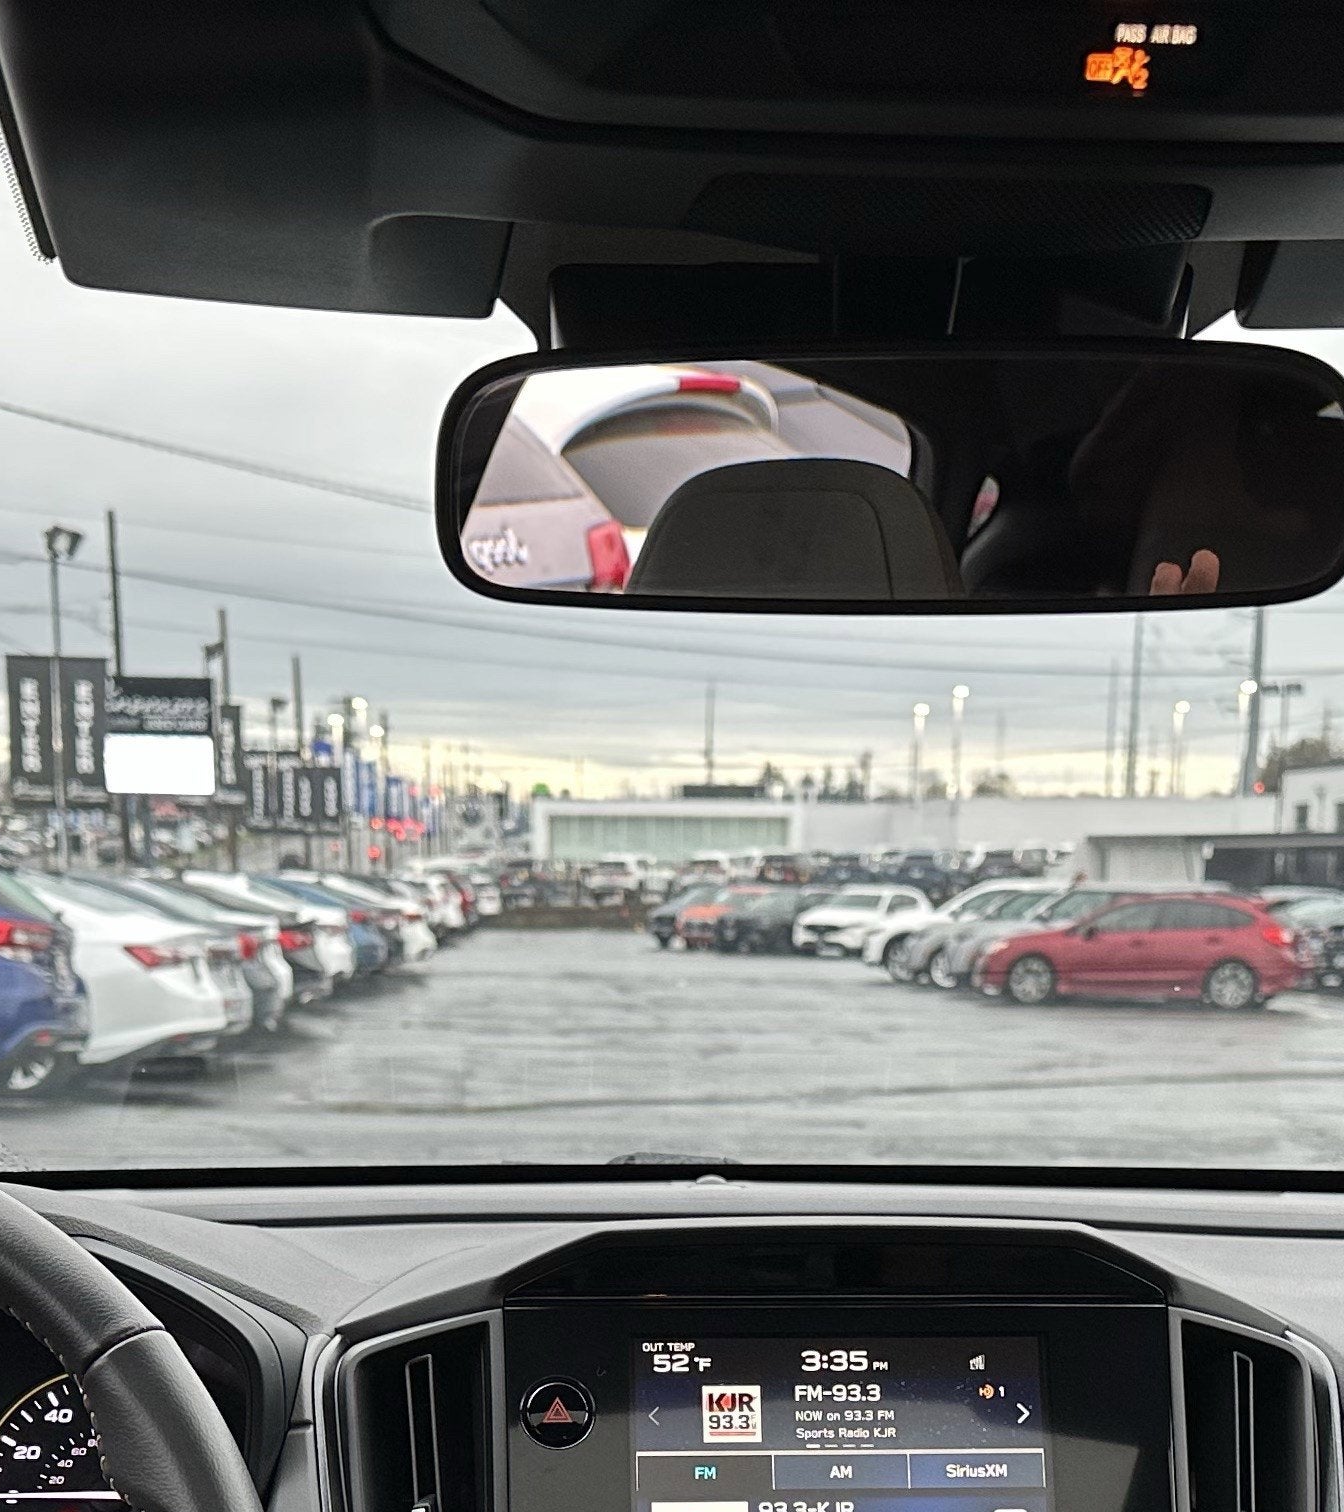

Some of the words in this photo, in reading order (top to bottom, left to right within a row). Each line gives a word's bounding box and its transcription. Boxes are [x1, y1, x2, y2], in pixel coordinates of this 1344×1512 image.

[1114, 23, 1147, 44] PASS
[1150, 24, 1171, 44] AIR
[1171, 24, 1198, 45] BAG
[642, 1343, 664, 1351] OUT
[667, 1343, 695, 1352] TEMP
[653, 1354, 690, 1372] 52
[801, 1350, 868, 1371] 3:35
[873, 1361, 888, 1371] PM
[794, 1384, 881, 1402] FM-93.3
[708, 1393, 756, 1413] KJR
[44, 1408, 73, 1423] 40
[708, 1415, 750, 1430] 93.3
[795, 1410, 823, 1421] NOW
[827, 1412, 841, 1421] on
[844, 1410, 874, 1421] 93.3
[877, 1410, 895, 1421] FM
[796, 1428, 835, 1439] Sports
[838, 1427, 870, 1438] Radio
[873, 1427, 897, 1438] KJR
[13, 1446, 41, 1460] 20
[71, 1447, 87, 1456] 60
[57, 1460, 74, 1468] 40
[945, 1464, 1008, 1478] SiriusXM
[694, 1466, 717, 1480] FM
[829, 1465, 853, 1479] AM
[48, 1475, 65, 1485] 20
